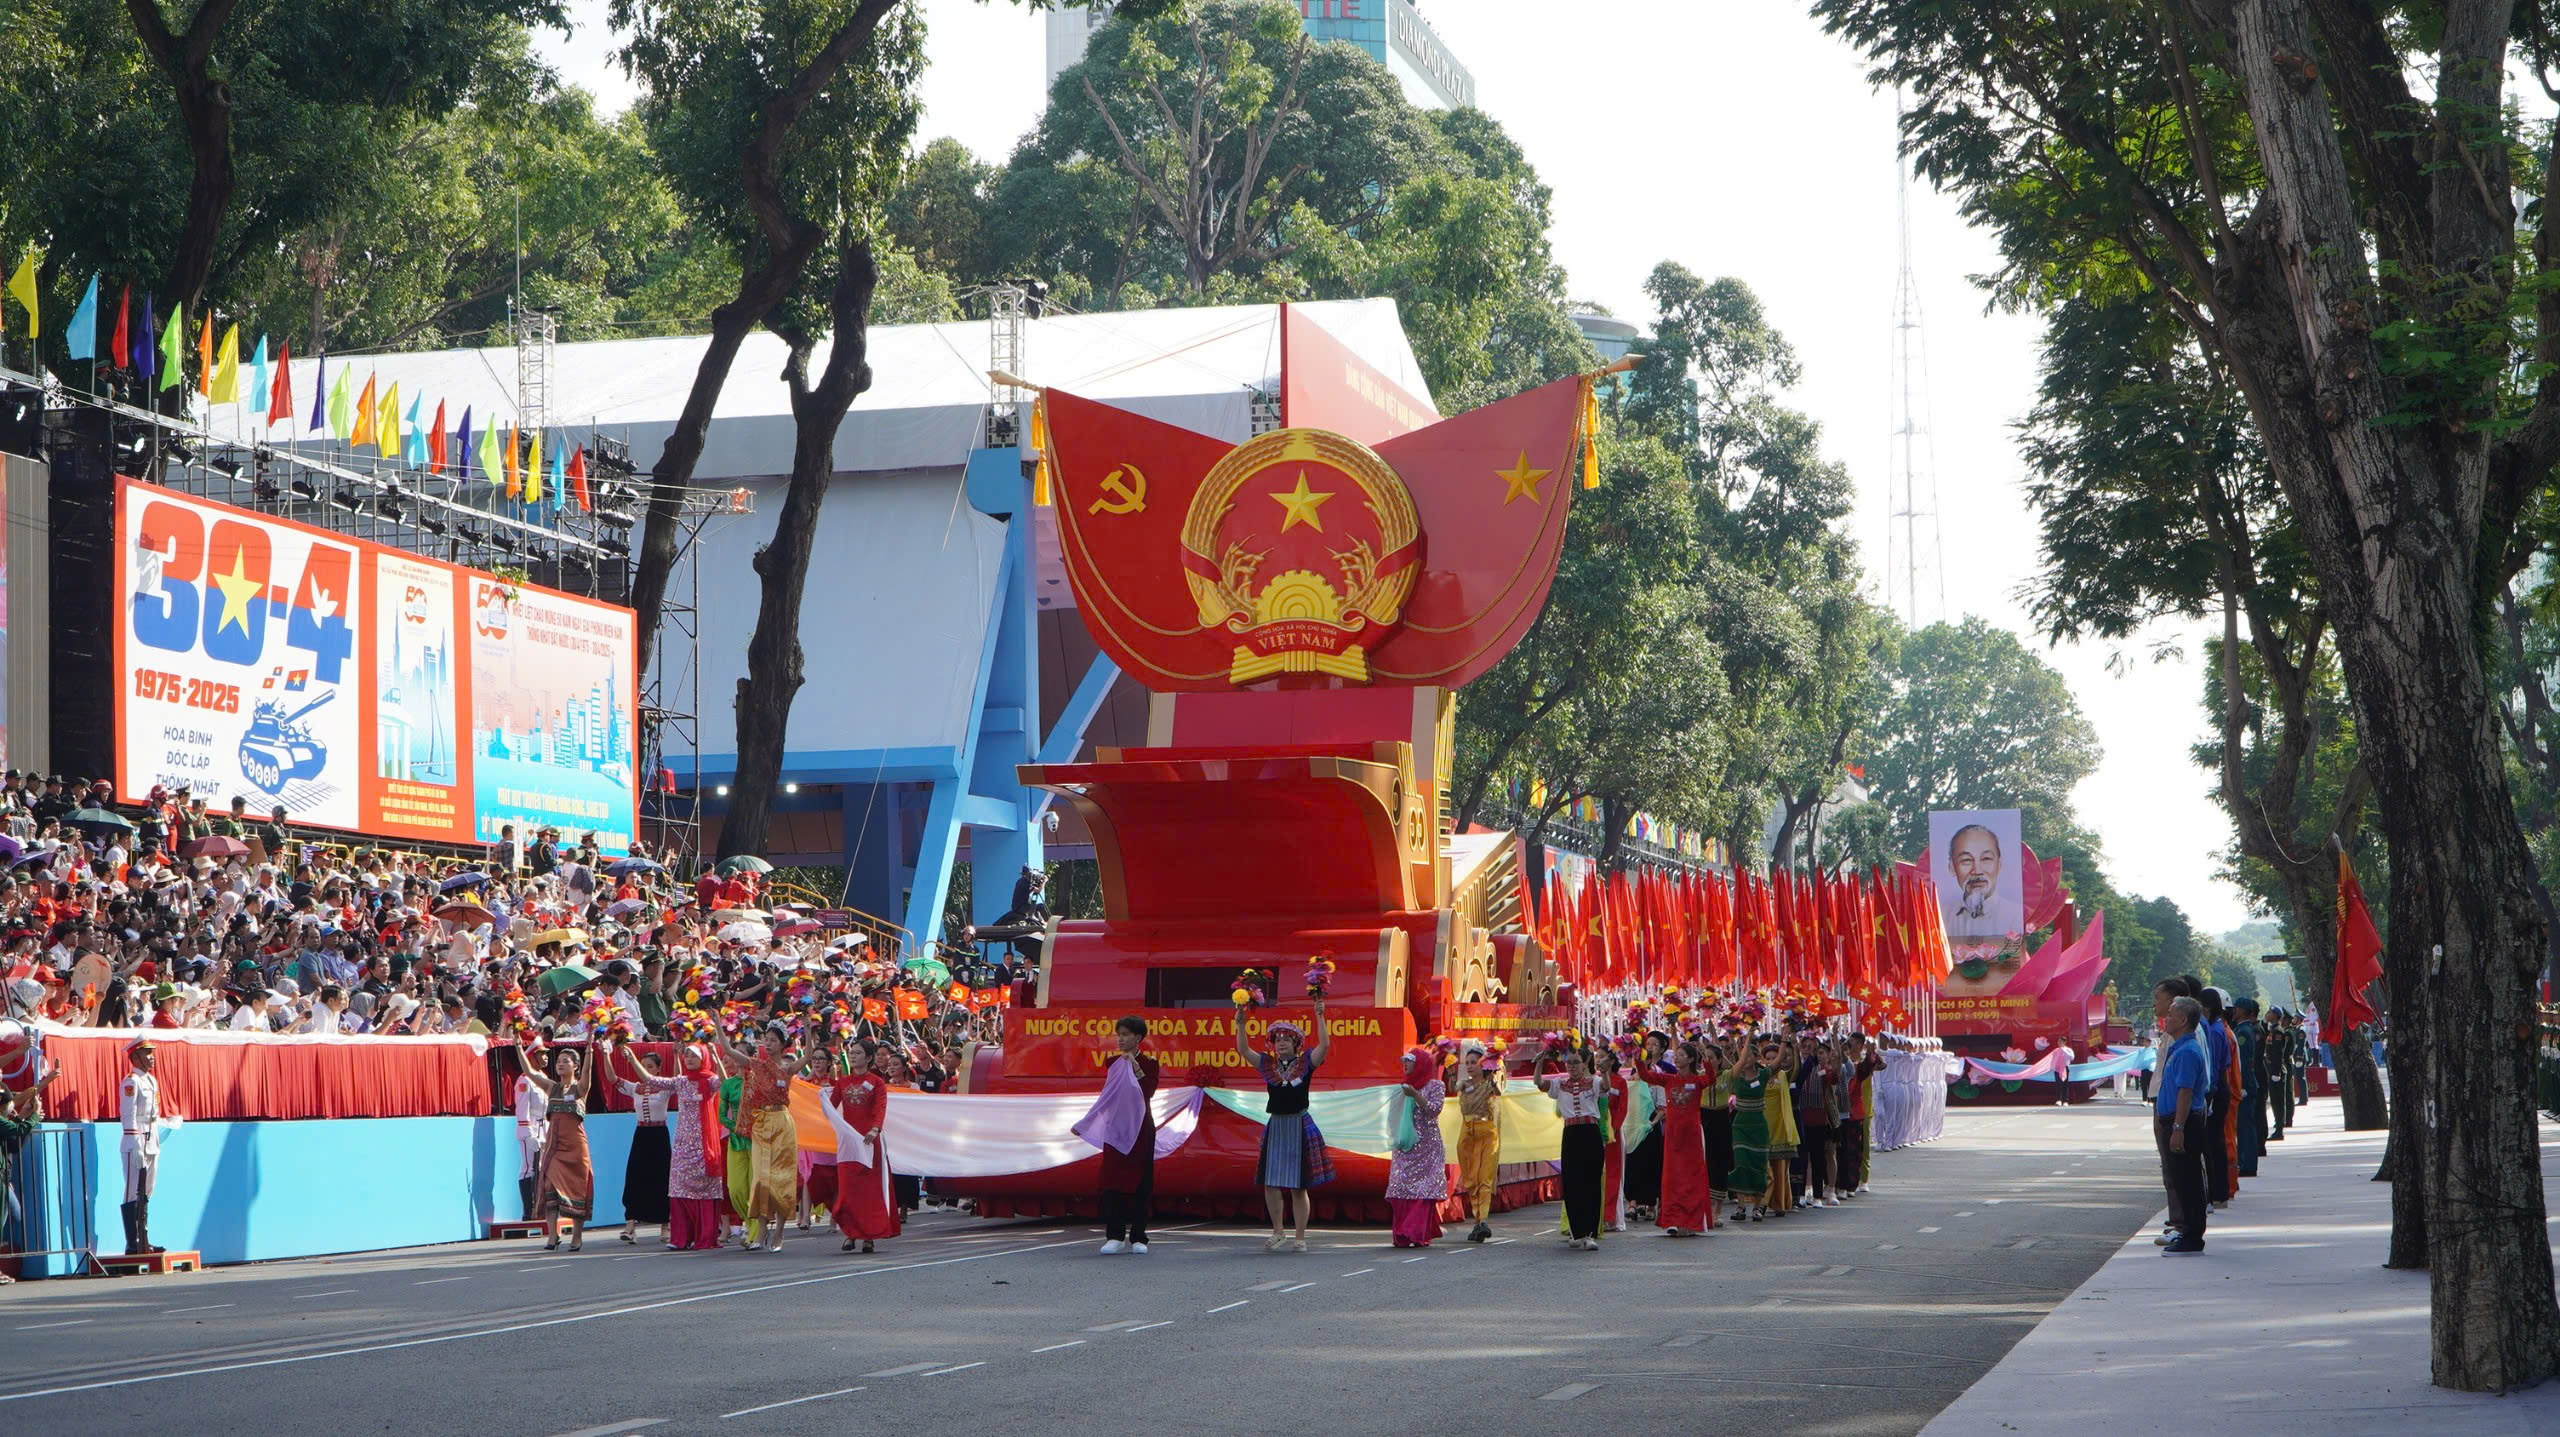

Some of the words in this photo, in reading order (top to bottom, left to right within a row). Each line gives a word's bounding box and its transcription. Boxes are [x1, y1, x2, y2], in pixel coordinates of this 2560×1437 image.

[1398, 9, 1440, 79] DIAMOND
[1440, 57, 1465, 104] PLAZA
[133, 501, 352, 684] 30-4
[1258, 632, 1296, 650] VIỆT
[1301, 633, 1337, 650] NAM
[166, 749, 189, 769] ĐỘC
[2000, 999, 2029, 1008] MINH
[1025, 1014, 1080, 1036] NƯỚC
[1145, 1016, 1188, 1036] HÒA
[1194, 1016, 1225, 1036] XÃ
